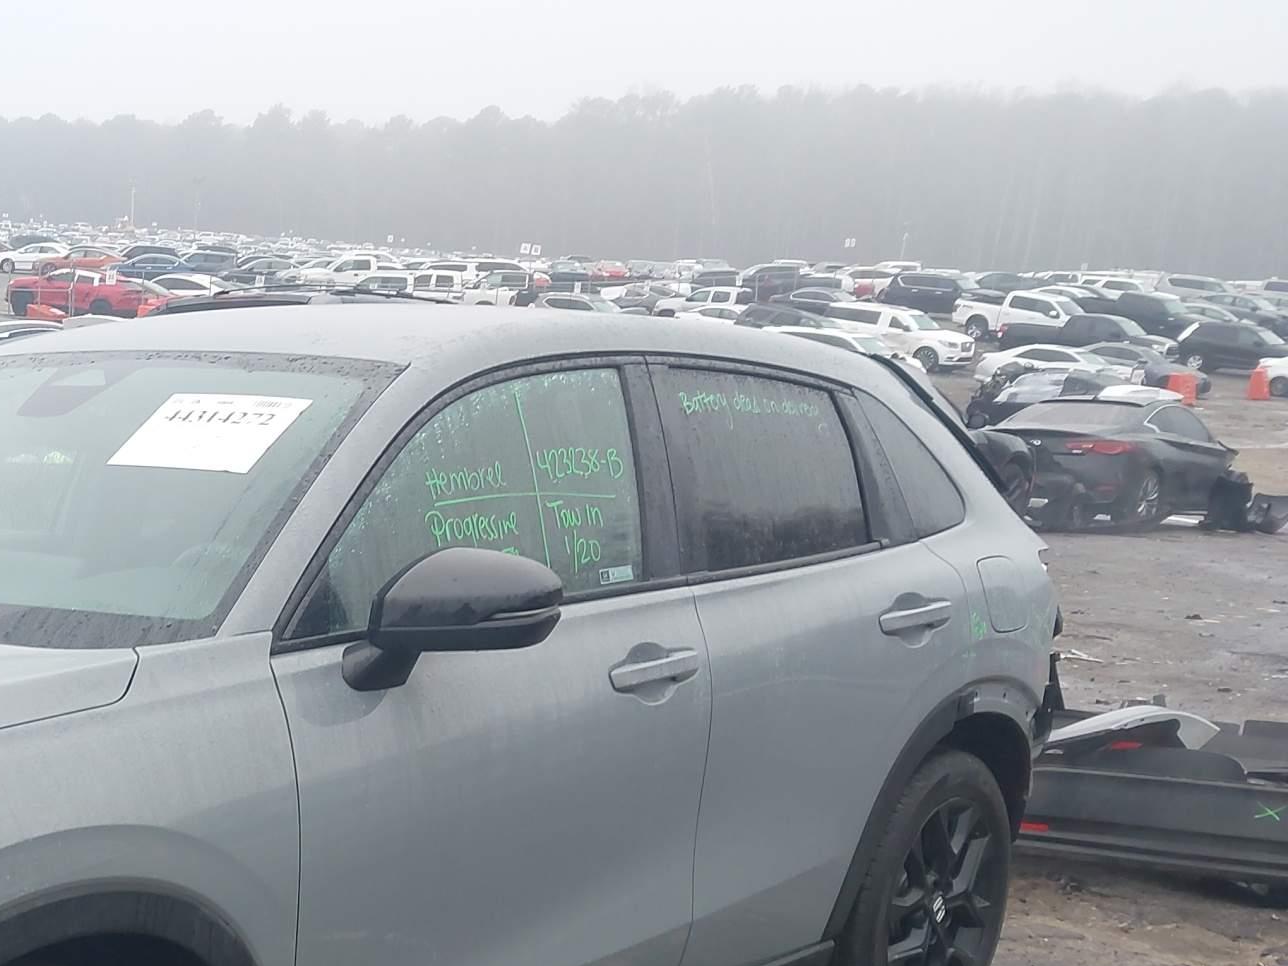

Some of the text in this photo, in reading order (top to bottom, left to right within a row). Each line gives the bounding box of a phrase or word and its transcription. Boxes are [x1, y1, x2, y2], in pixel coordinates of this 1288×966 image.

[164, 409, 276, 426] 44314272
[536, 447, 623, 480] 423238-B
[545, 500, 581, 529] Tow
[565, 529, 601, 574] 1/20
